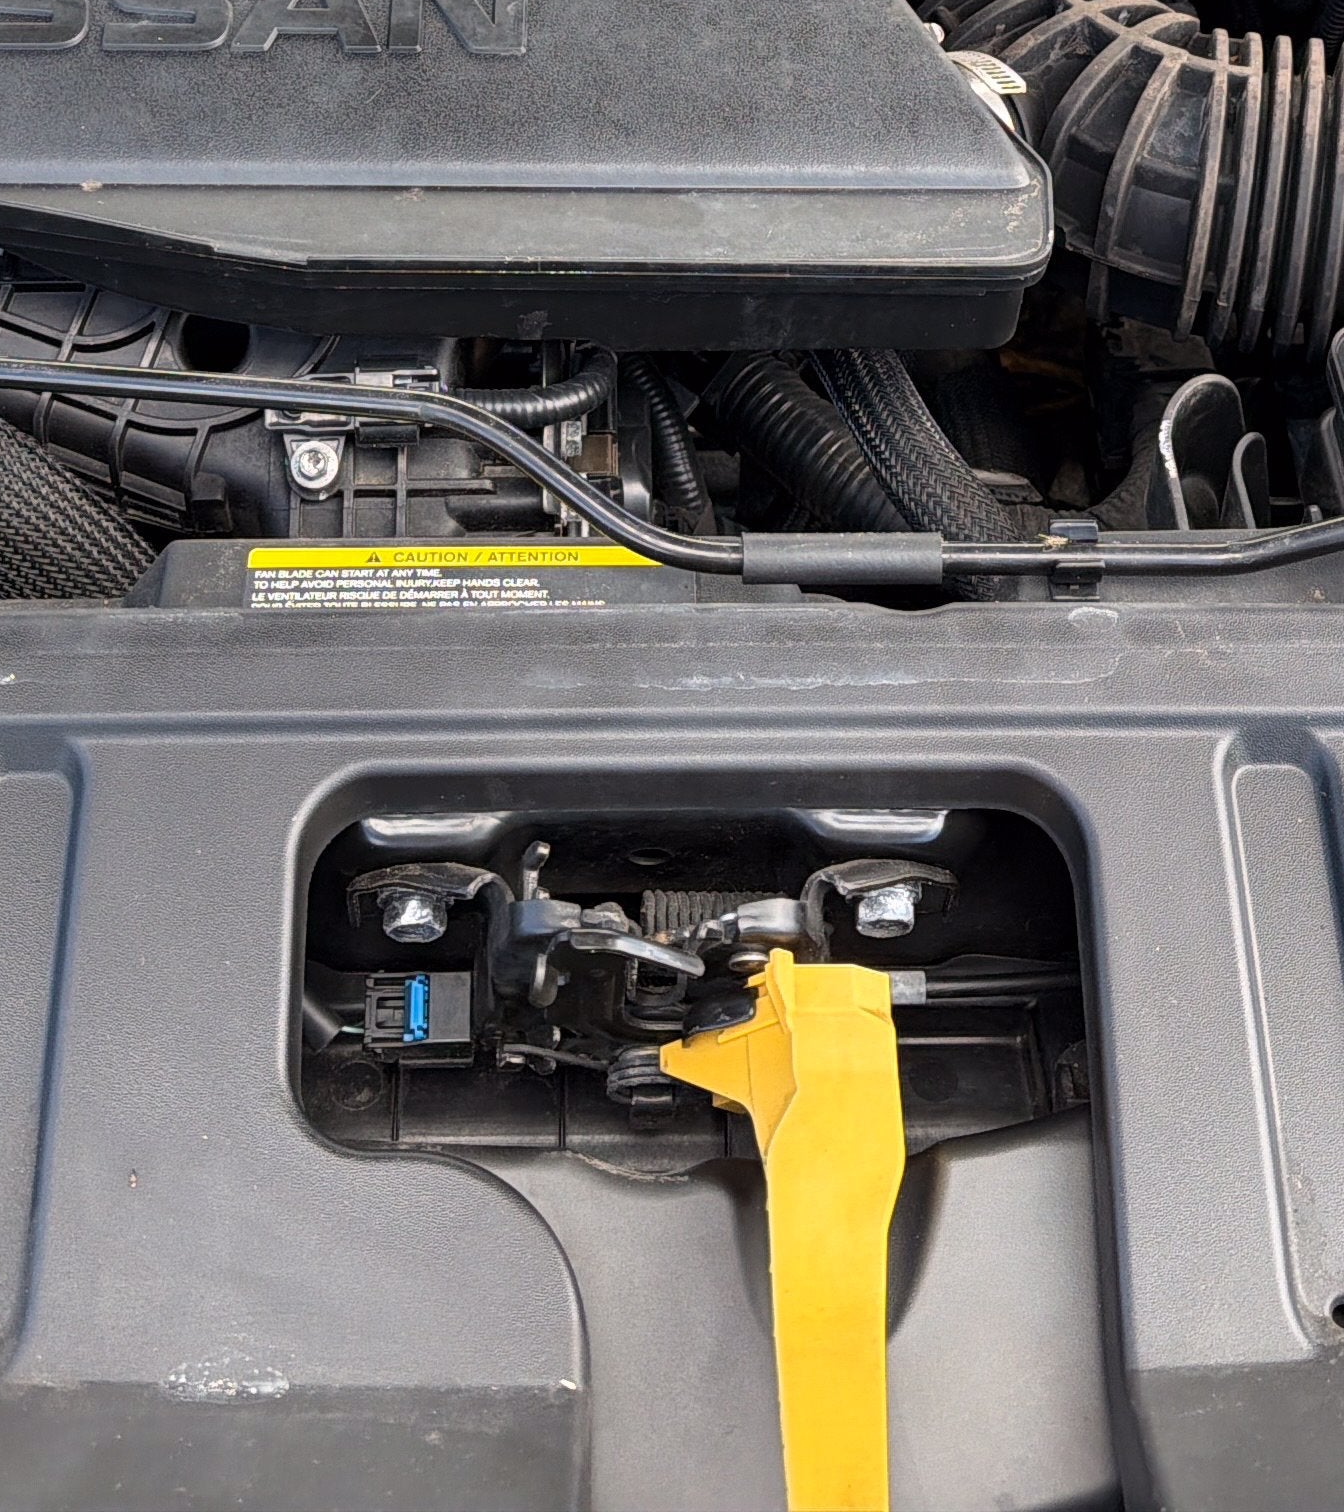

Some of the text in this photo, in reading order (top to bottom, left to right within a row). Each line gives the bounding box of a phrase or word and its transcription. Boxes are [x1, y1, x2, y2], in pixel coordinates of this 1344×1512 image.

[393, 551, 579, 563] CAUTION / ATTENTION
[254, 570, 276, 578] FAN
[277, 569, 313, 578] BLADE
[315, 569, 340, 578] CAN
[341, 569, 374, 578] START
[376, 569, 390, 578] AT
[391, 569, 414, 577] ANY
[253, 581, 268, 589] TO
[270, 581, 300, 589] HELP
[301, 580, 335, 589] AVOID
[336, 579, 394, 588] PERSONAL
[462, 579, 500, 587] HANDS
[251, 592, 266, 601] LE
[267, 591, 337, 601] VENTILATEUR
[339, 591, 380, 600] RISQUE
[381, 591, 398, 600] DE
[470, 590, 499, 599] TOUT
